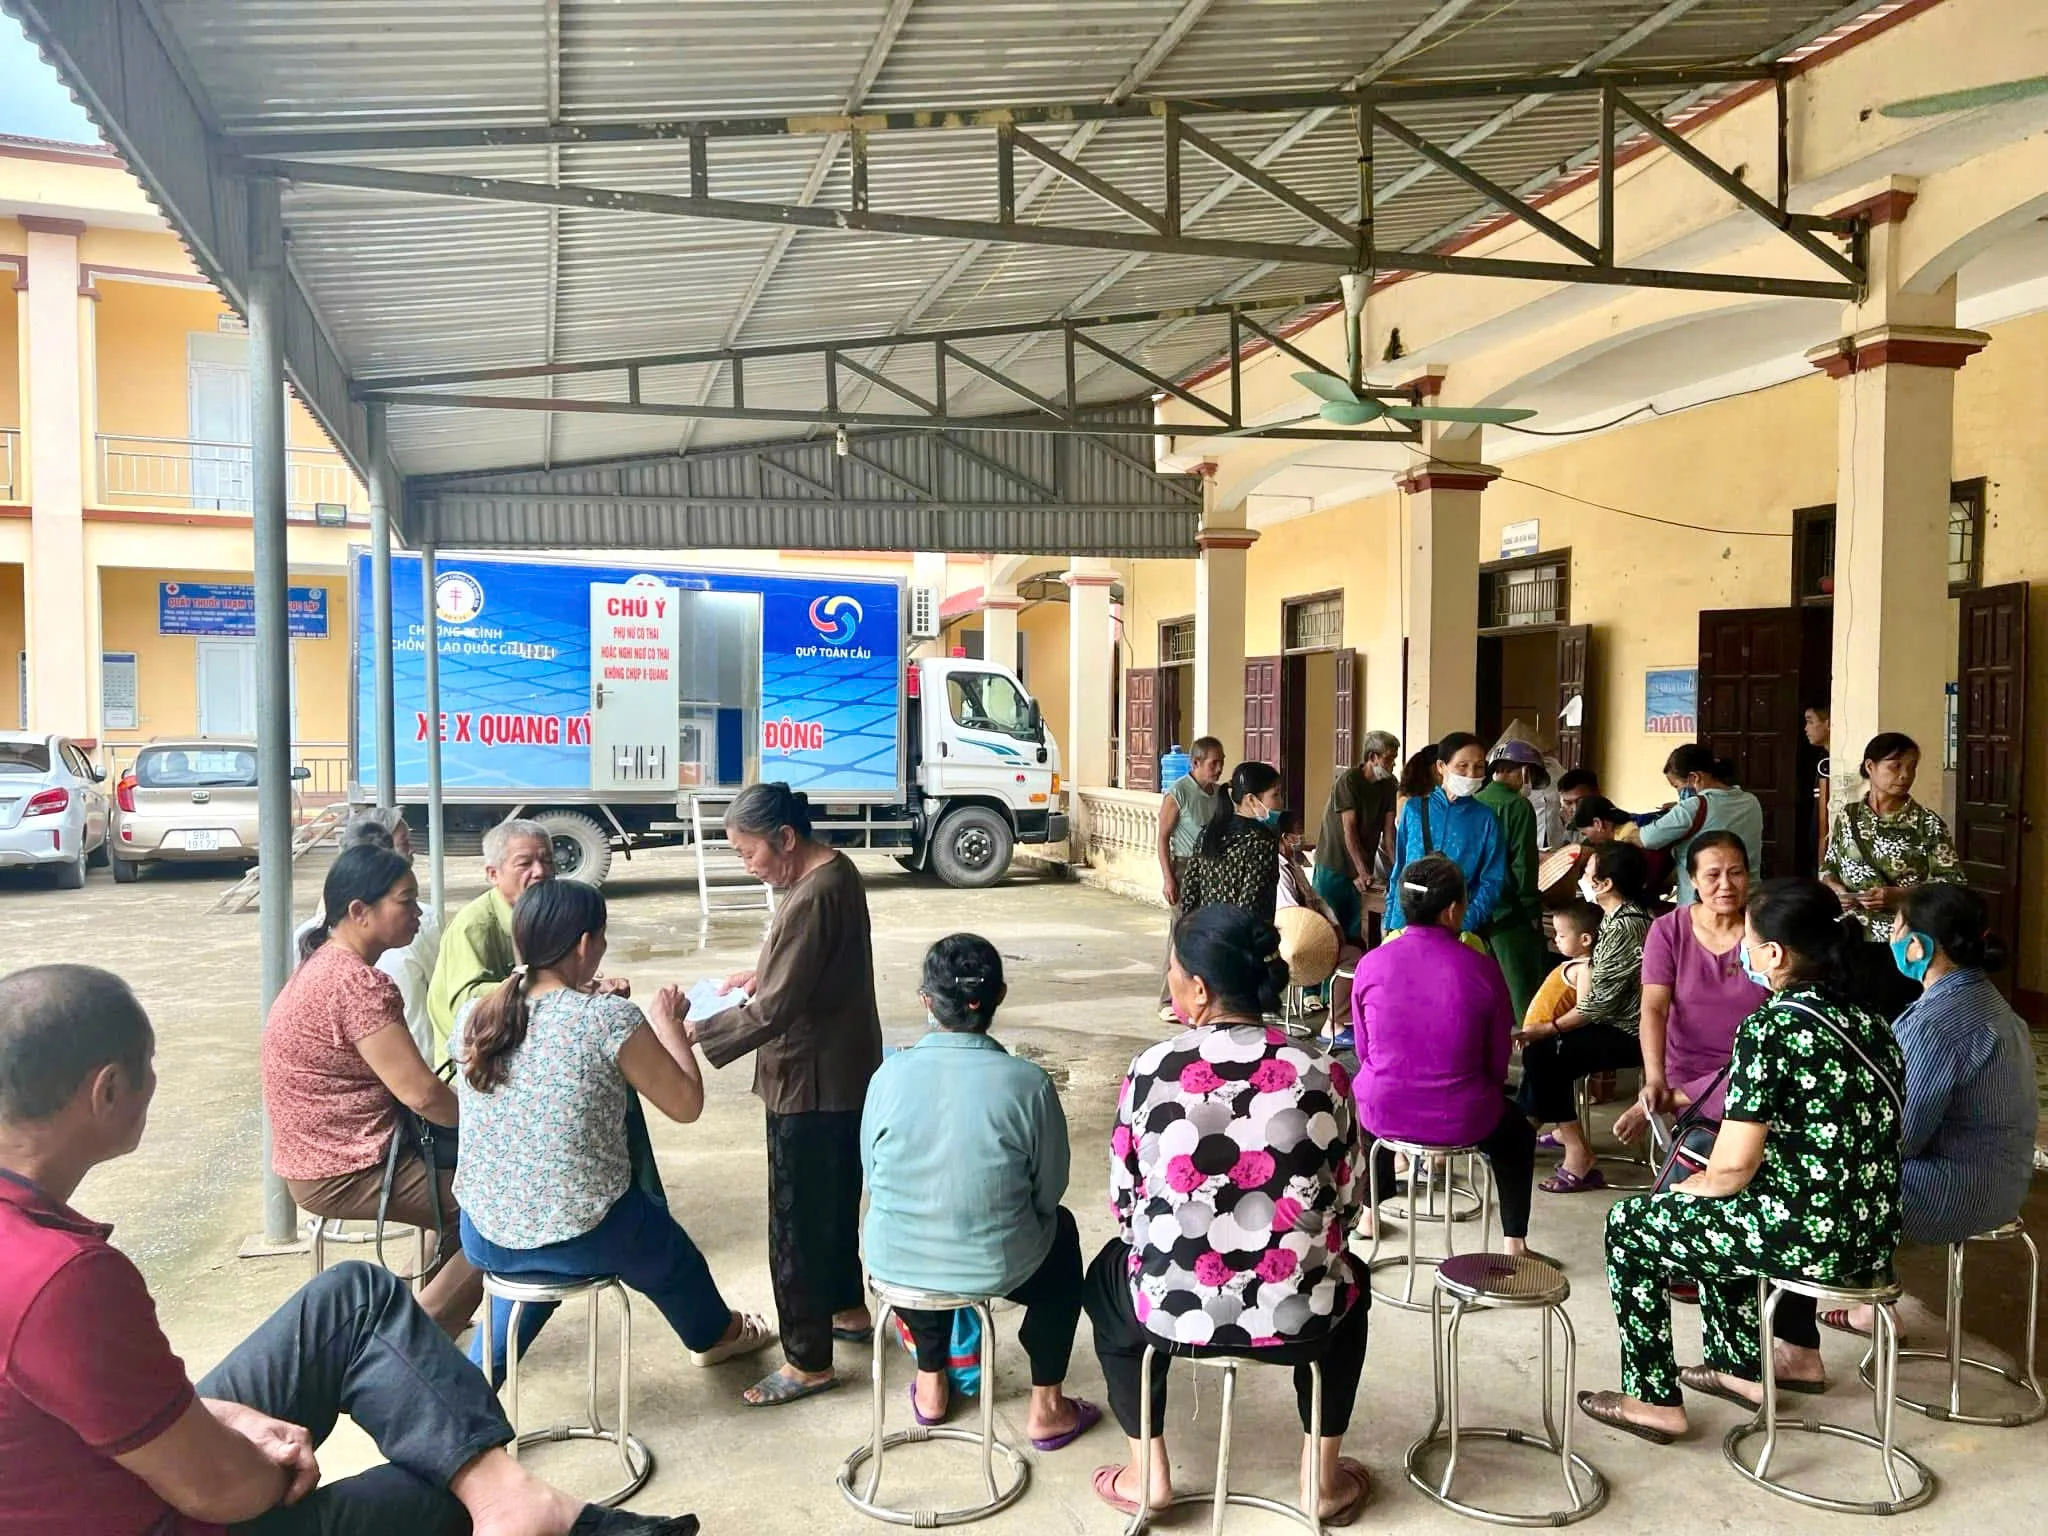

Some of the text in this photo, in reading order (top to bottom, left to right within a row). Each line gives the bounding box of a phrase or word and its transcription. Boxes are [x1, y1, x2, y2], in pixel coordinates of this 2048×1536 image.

[607, 596, 666, 619] CHÚ Ý
[464, 625, 503, 640] ÌNH
[392, 636, 425, 651] CHỐN
[416, 712, 447, 742] XE
[456, 713, 471, 743] X
[479, 714, 559, 746] QUANG
[764, 716, 823, 755] ĐỘNG
